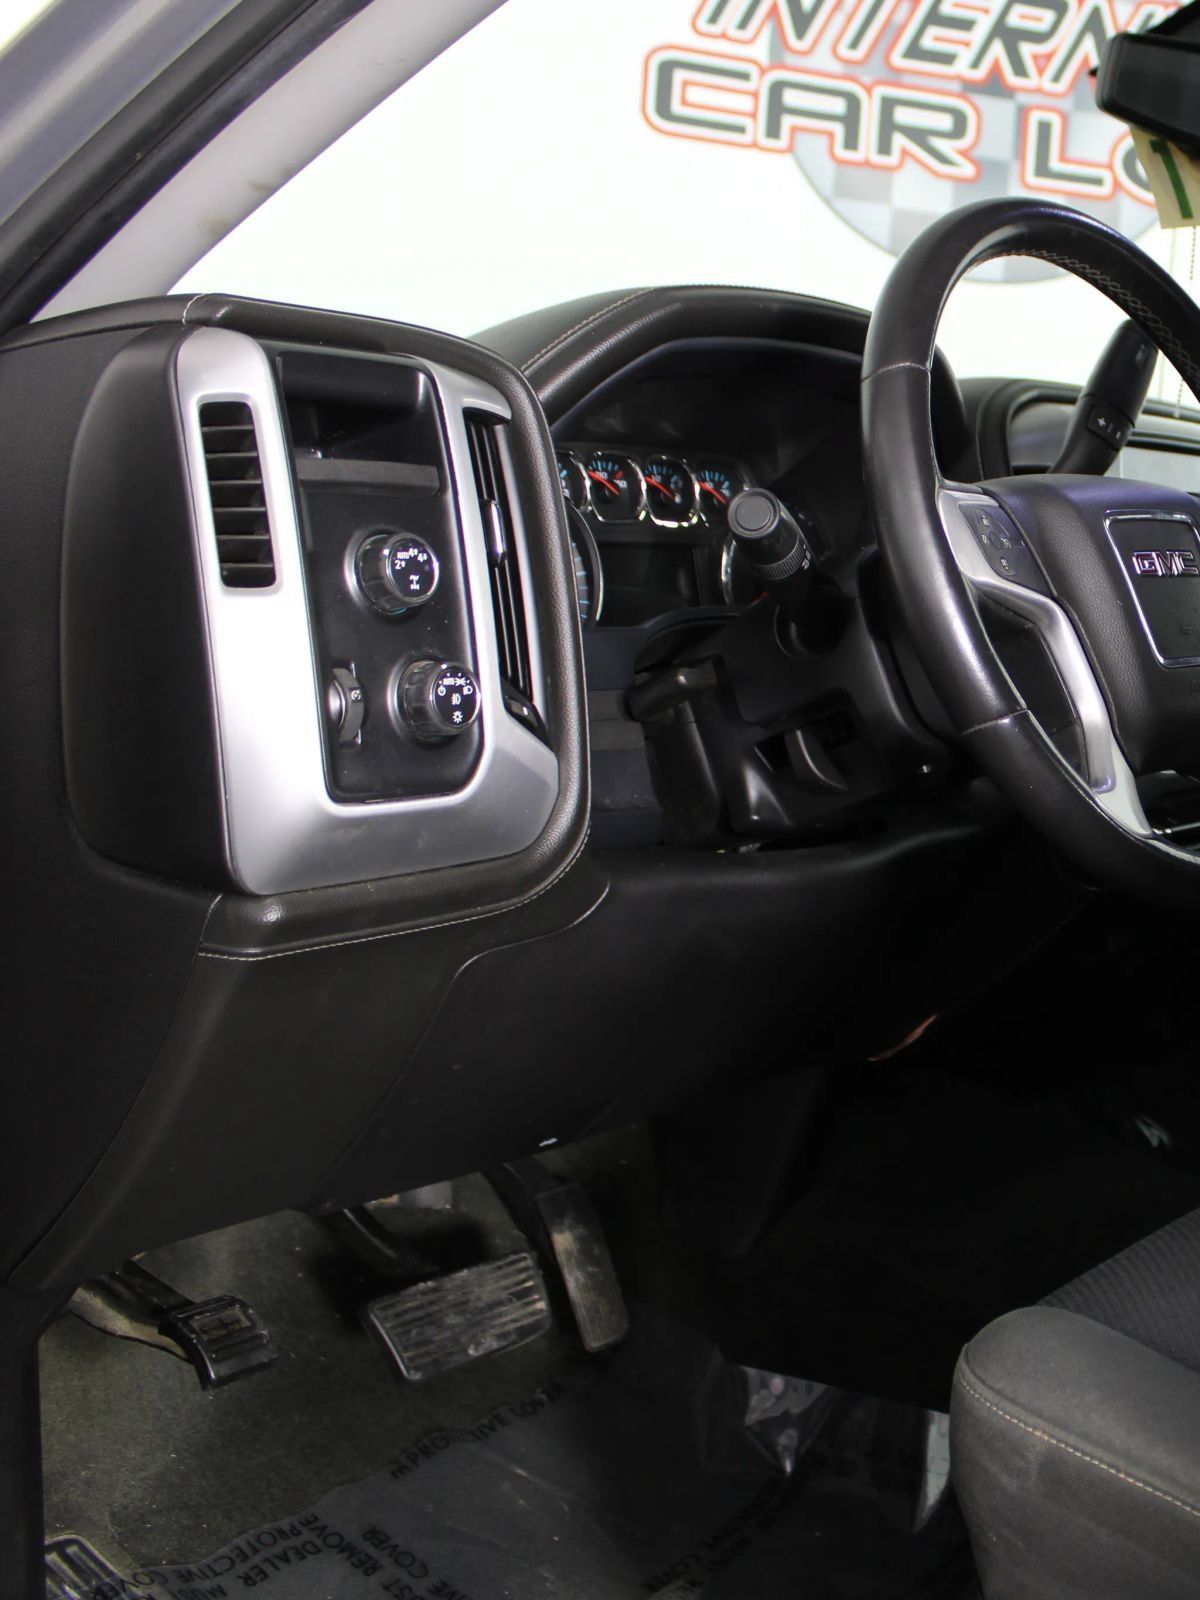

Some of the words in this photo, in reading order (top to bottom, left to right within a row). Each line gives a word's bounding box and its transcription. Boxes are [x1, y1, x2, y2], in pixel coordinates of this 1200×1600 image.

[645, 47, 978, 180] CAR
[1131, 551, 1200, 577] GMC
[170, 1522, 304, 1584] PROTECTIVE
[237, 1539, 322, 1588] DEALER
[298, 1512, 384, 1578] REMOVE
[361, 1524, 429, 1580] COVER
